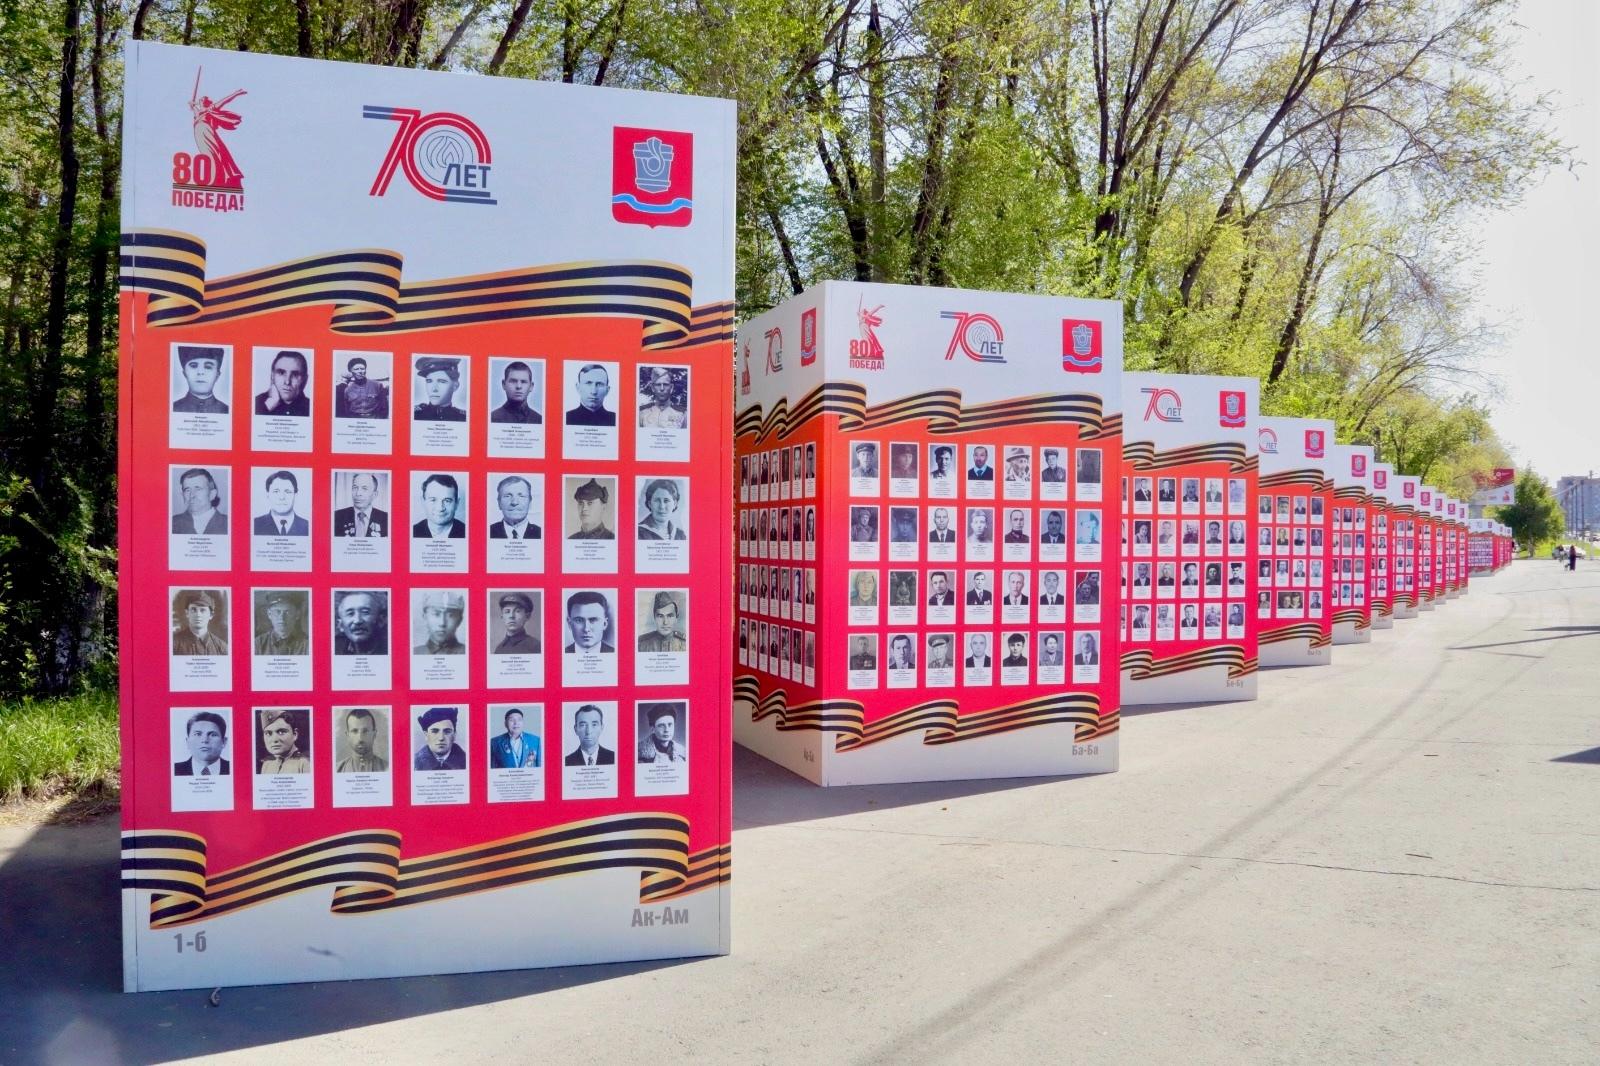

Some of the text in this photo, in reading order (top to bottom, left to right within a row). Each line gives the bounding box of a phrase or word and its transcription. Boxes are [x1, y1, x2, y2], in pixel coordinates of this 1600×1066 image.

[363, 105, 494, 202] 70 ЛЕТ
[173, 152, 212, 186] 80
[172, 189, 244, 212] ПОБЕДА!
[849, 339, 870, 357] 80
[941, 311, 1005, 362] 70 ЛЕТ
[849, 359, 885, 371] ПОБЕДА!
[1141, 388, 1182, 422] 70 ЛЕТ
[631, 906, 689, 928] Ак-Ам
